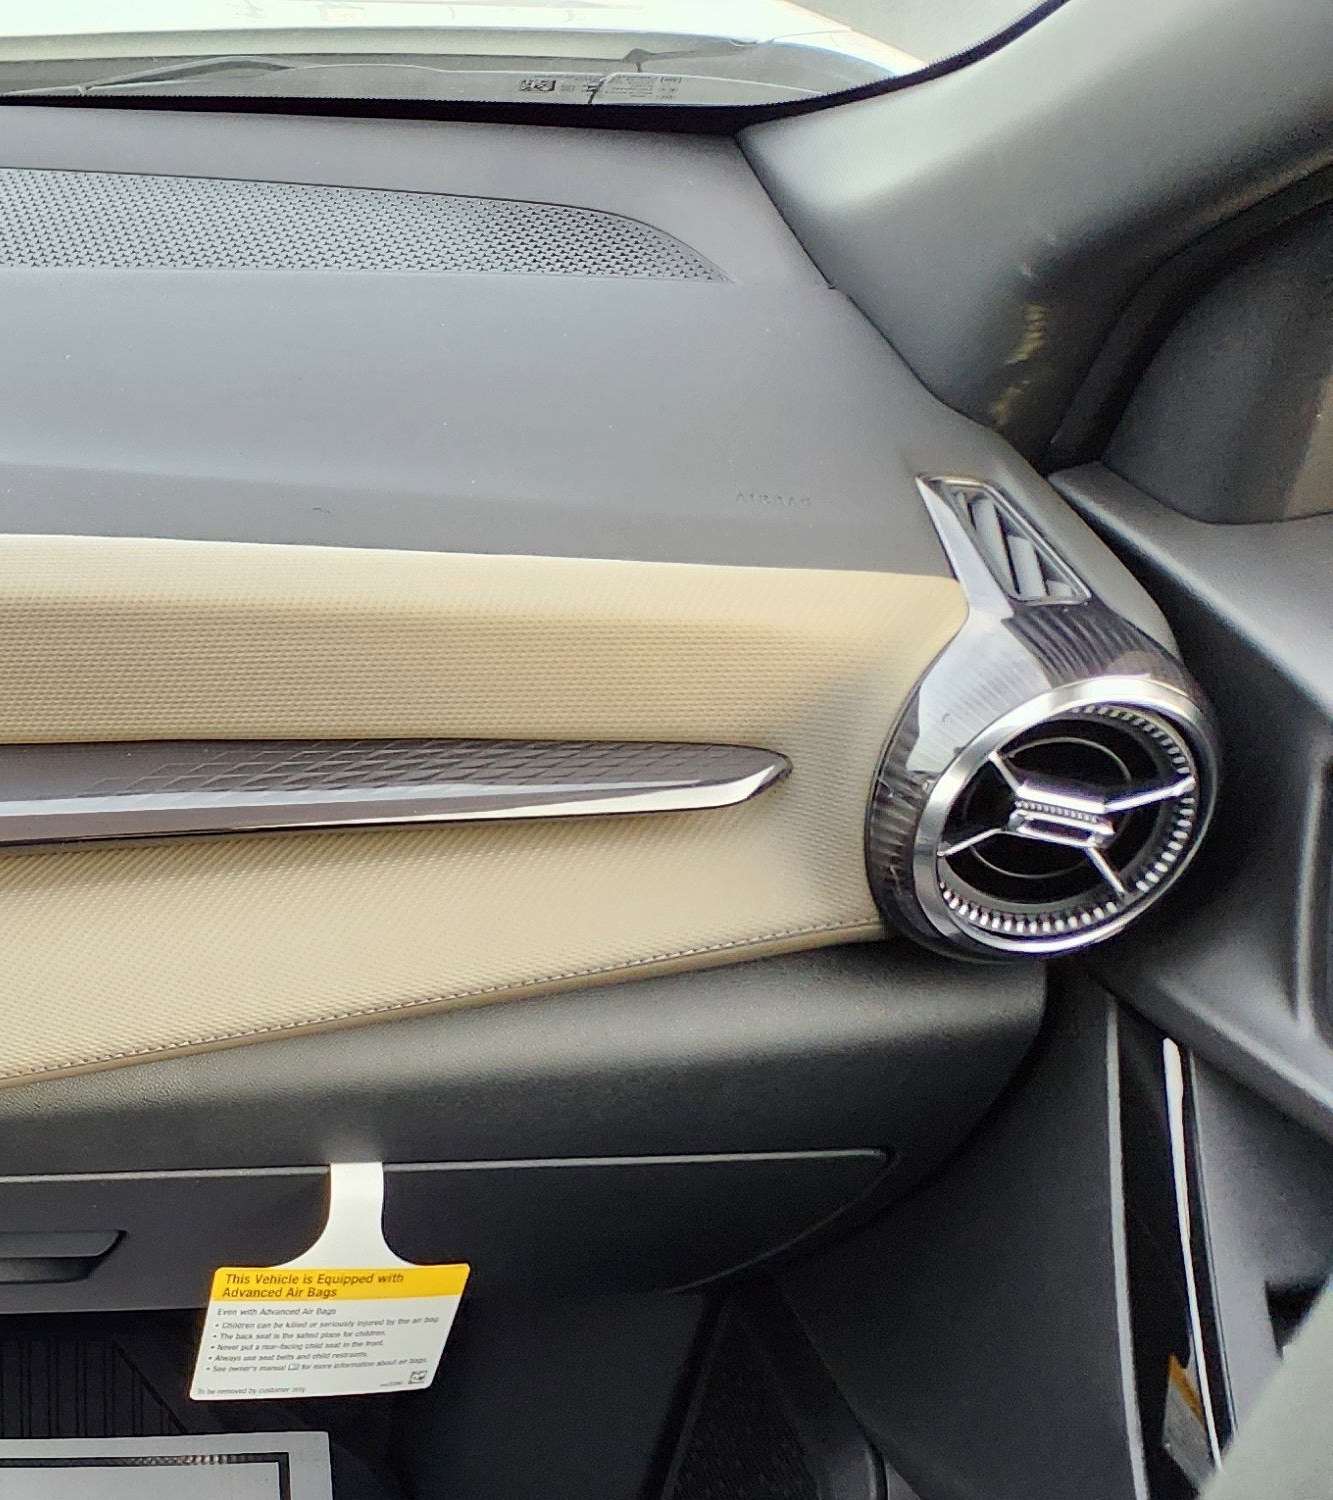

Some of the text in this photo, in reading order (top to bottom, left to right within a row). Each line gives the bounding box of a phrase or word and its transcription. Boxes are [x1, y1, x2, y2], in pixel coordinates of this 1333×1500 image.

[226, 1274, 404, 1286] This Vehicle is Equipped with
[222, 1287, 337, 1299] Advanced Air Bags
[316, 1308, 336, 1316] Bags
